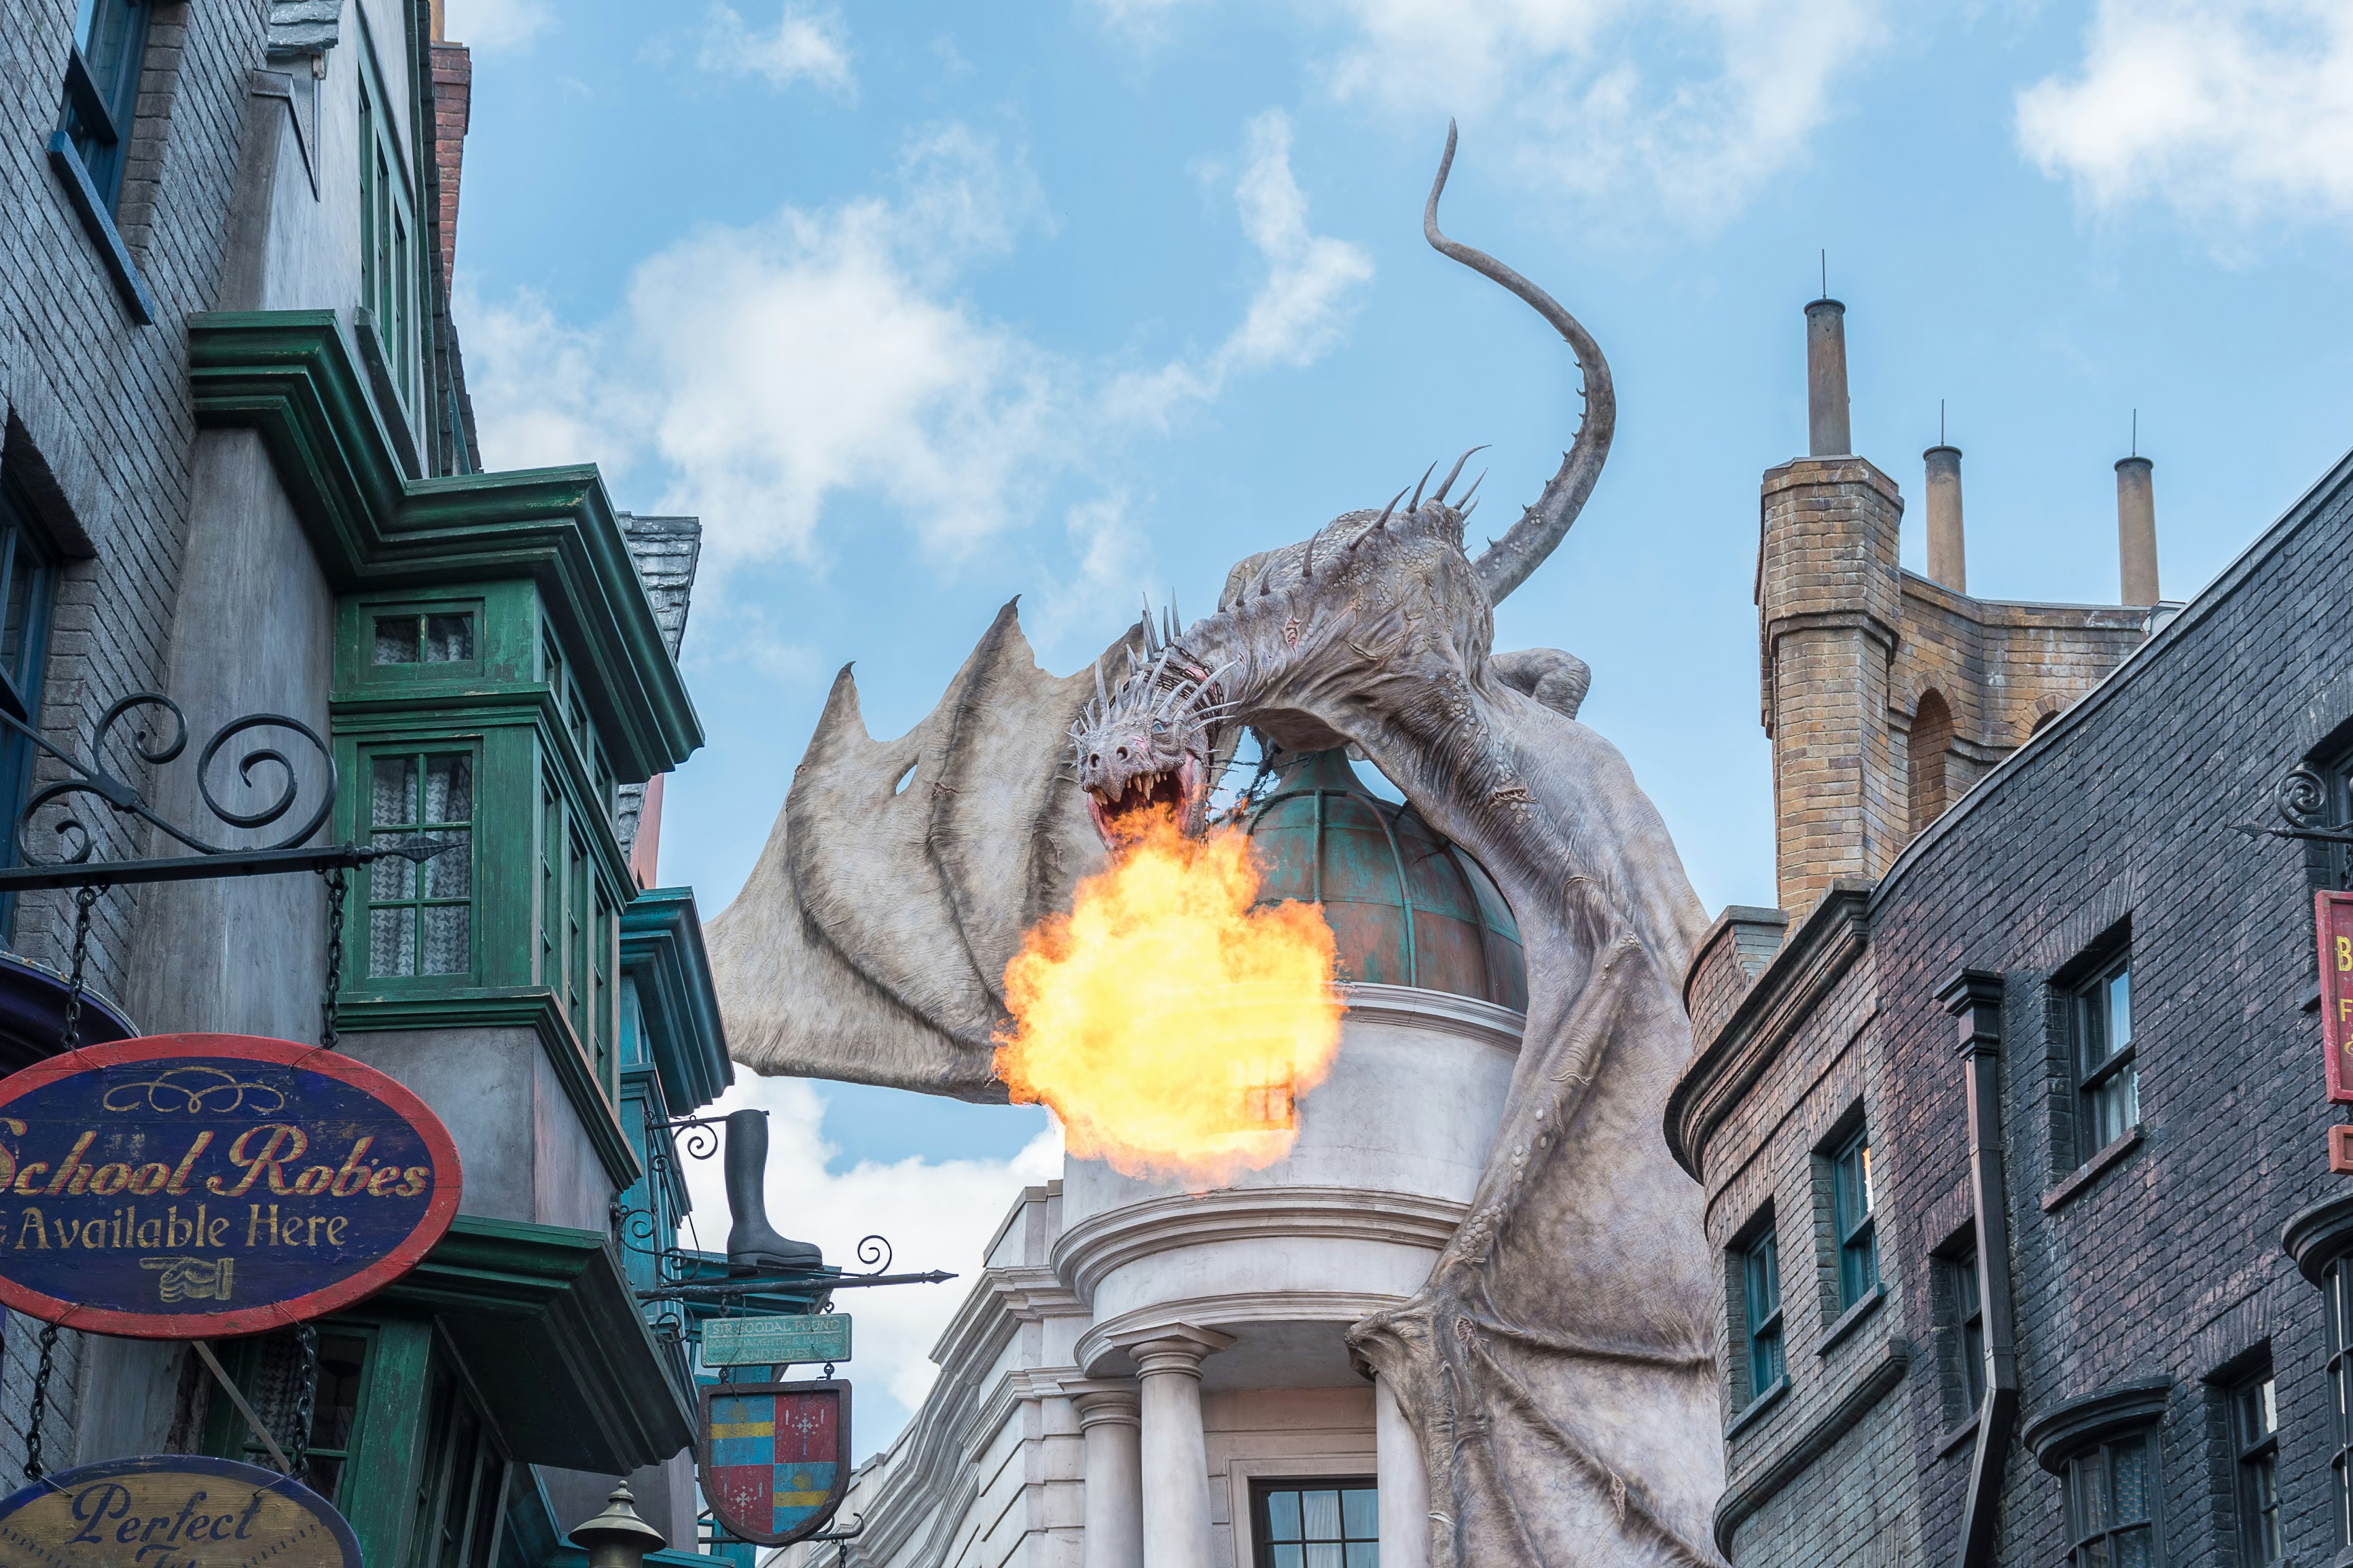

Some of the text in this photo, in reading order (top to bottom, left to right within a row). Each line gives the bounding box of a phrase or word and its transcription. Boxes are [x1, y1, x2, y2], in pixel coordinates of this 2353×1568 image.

[206, 1123, 431, 1198] Robes
[14, 1204, 349, 1250] Available Here
[713, 1323, 734, 1334] SIR
[739, 1347, 810, 1360] AND ELVES
[65, 1483, 262, 1544] Perfect
